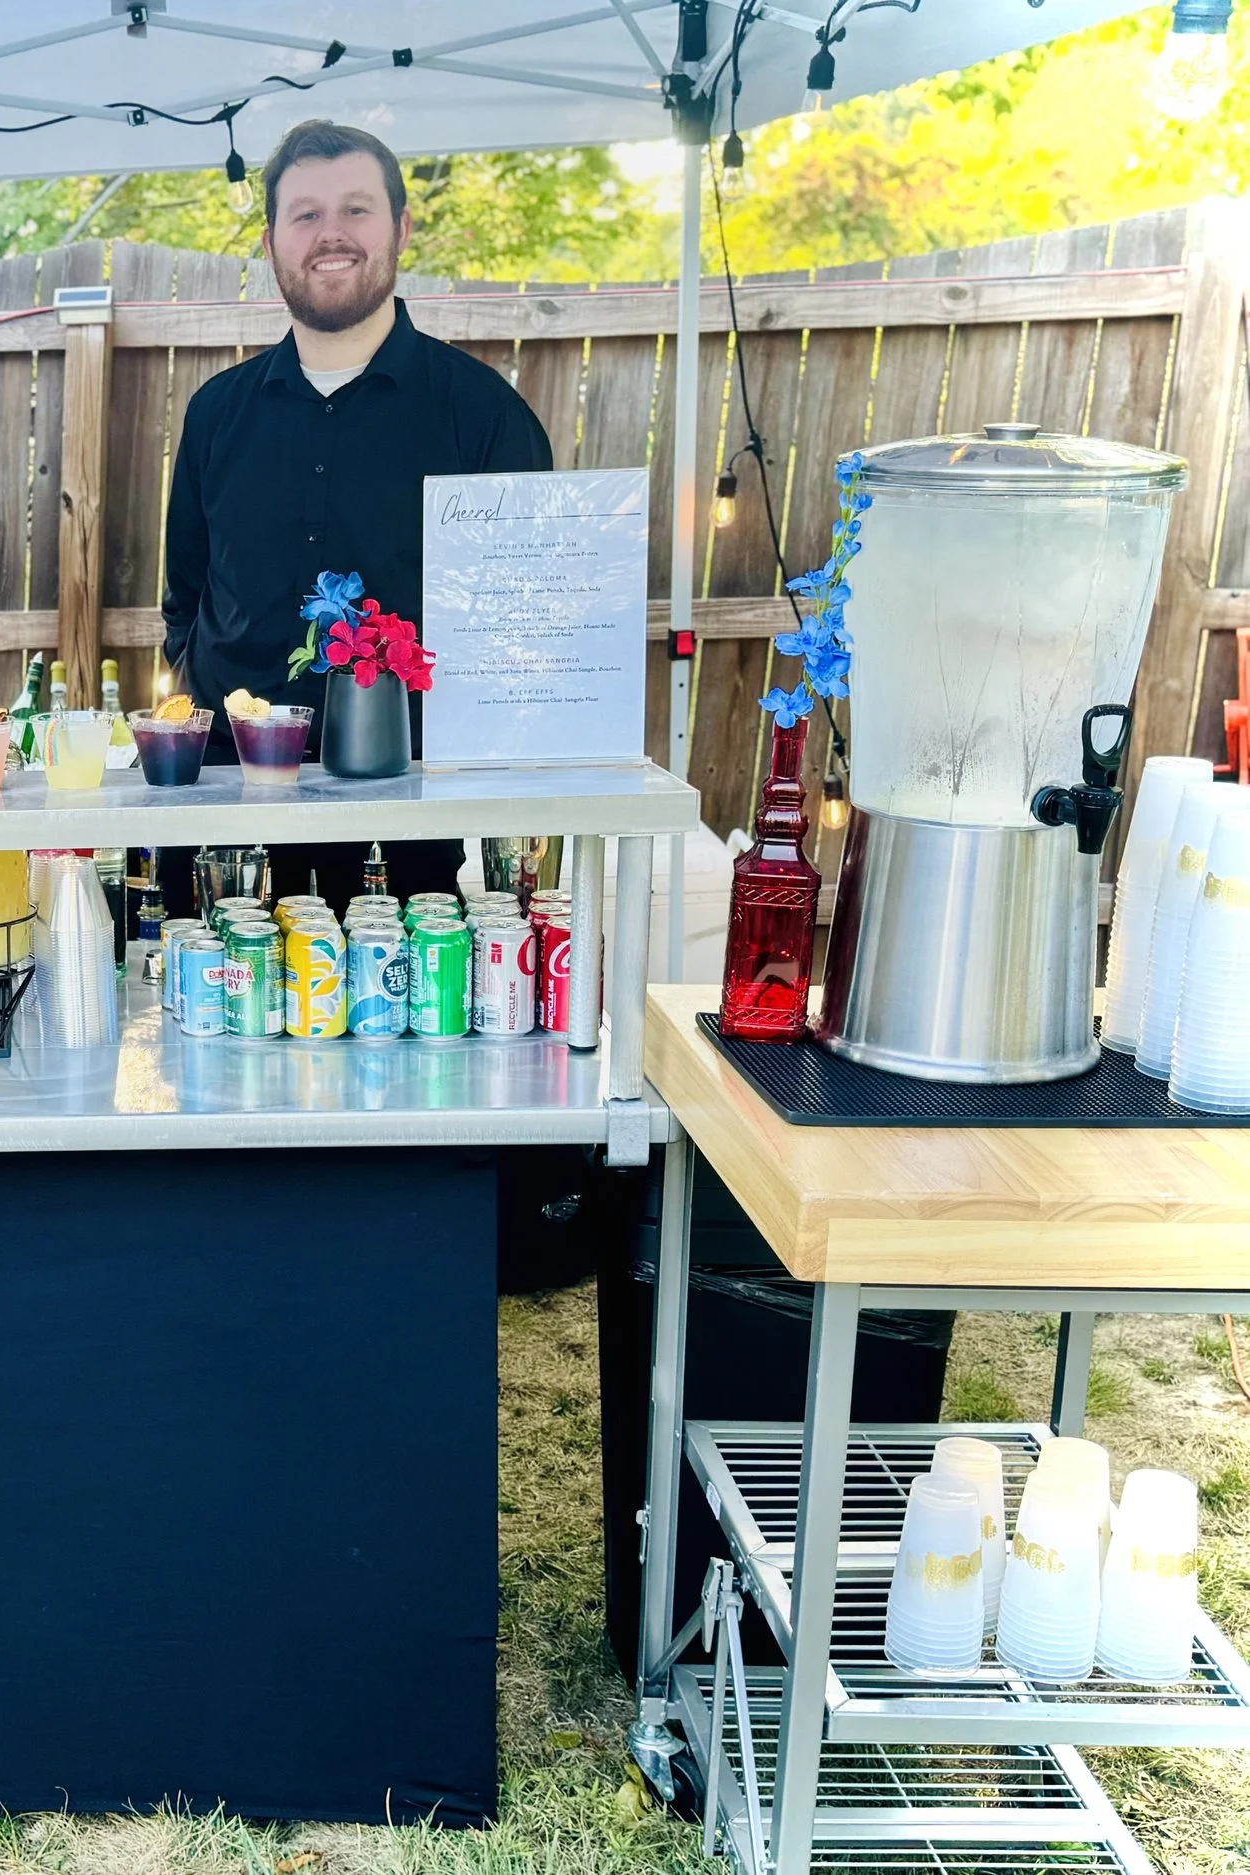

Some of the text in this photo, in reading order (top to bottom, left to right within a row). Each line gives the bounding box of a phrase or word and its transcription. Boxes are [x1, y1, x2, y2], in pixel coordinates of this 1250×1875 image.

[441, 488, 505, 526] Cheers!
[225, 969, 255, 981] NADA
[388, 974, 408, 988] ZER
[225, 981, 240, 990] RY
[549, 978, 554, 993] ME
[508, 980, 516, 1030] RECYCLE ME
